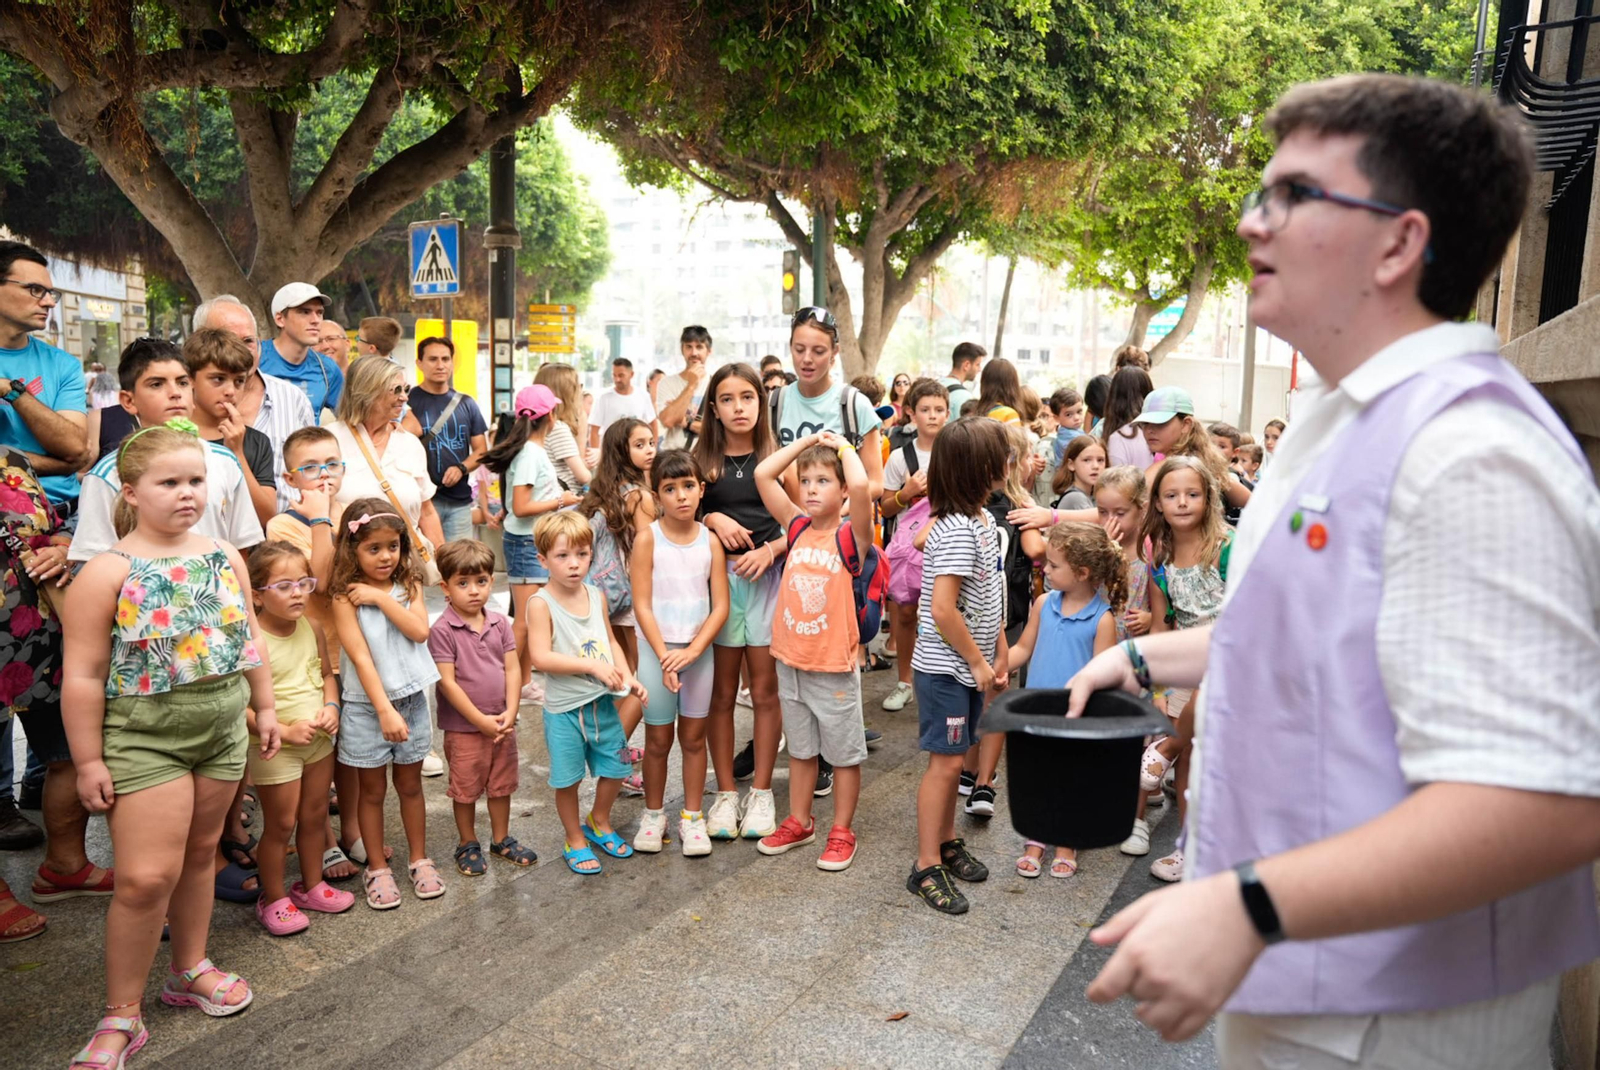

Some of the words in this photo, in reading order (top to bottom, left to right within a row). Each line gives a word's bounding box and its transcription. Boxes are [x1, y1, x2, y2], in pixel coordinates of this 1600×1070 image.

[788, 547, 841, 574] OING
[795, 614, 828, 635] BEST
[324, 853, 342, 865] PUMA
